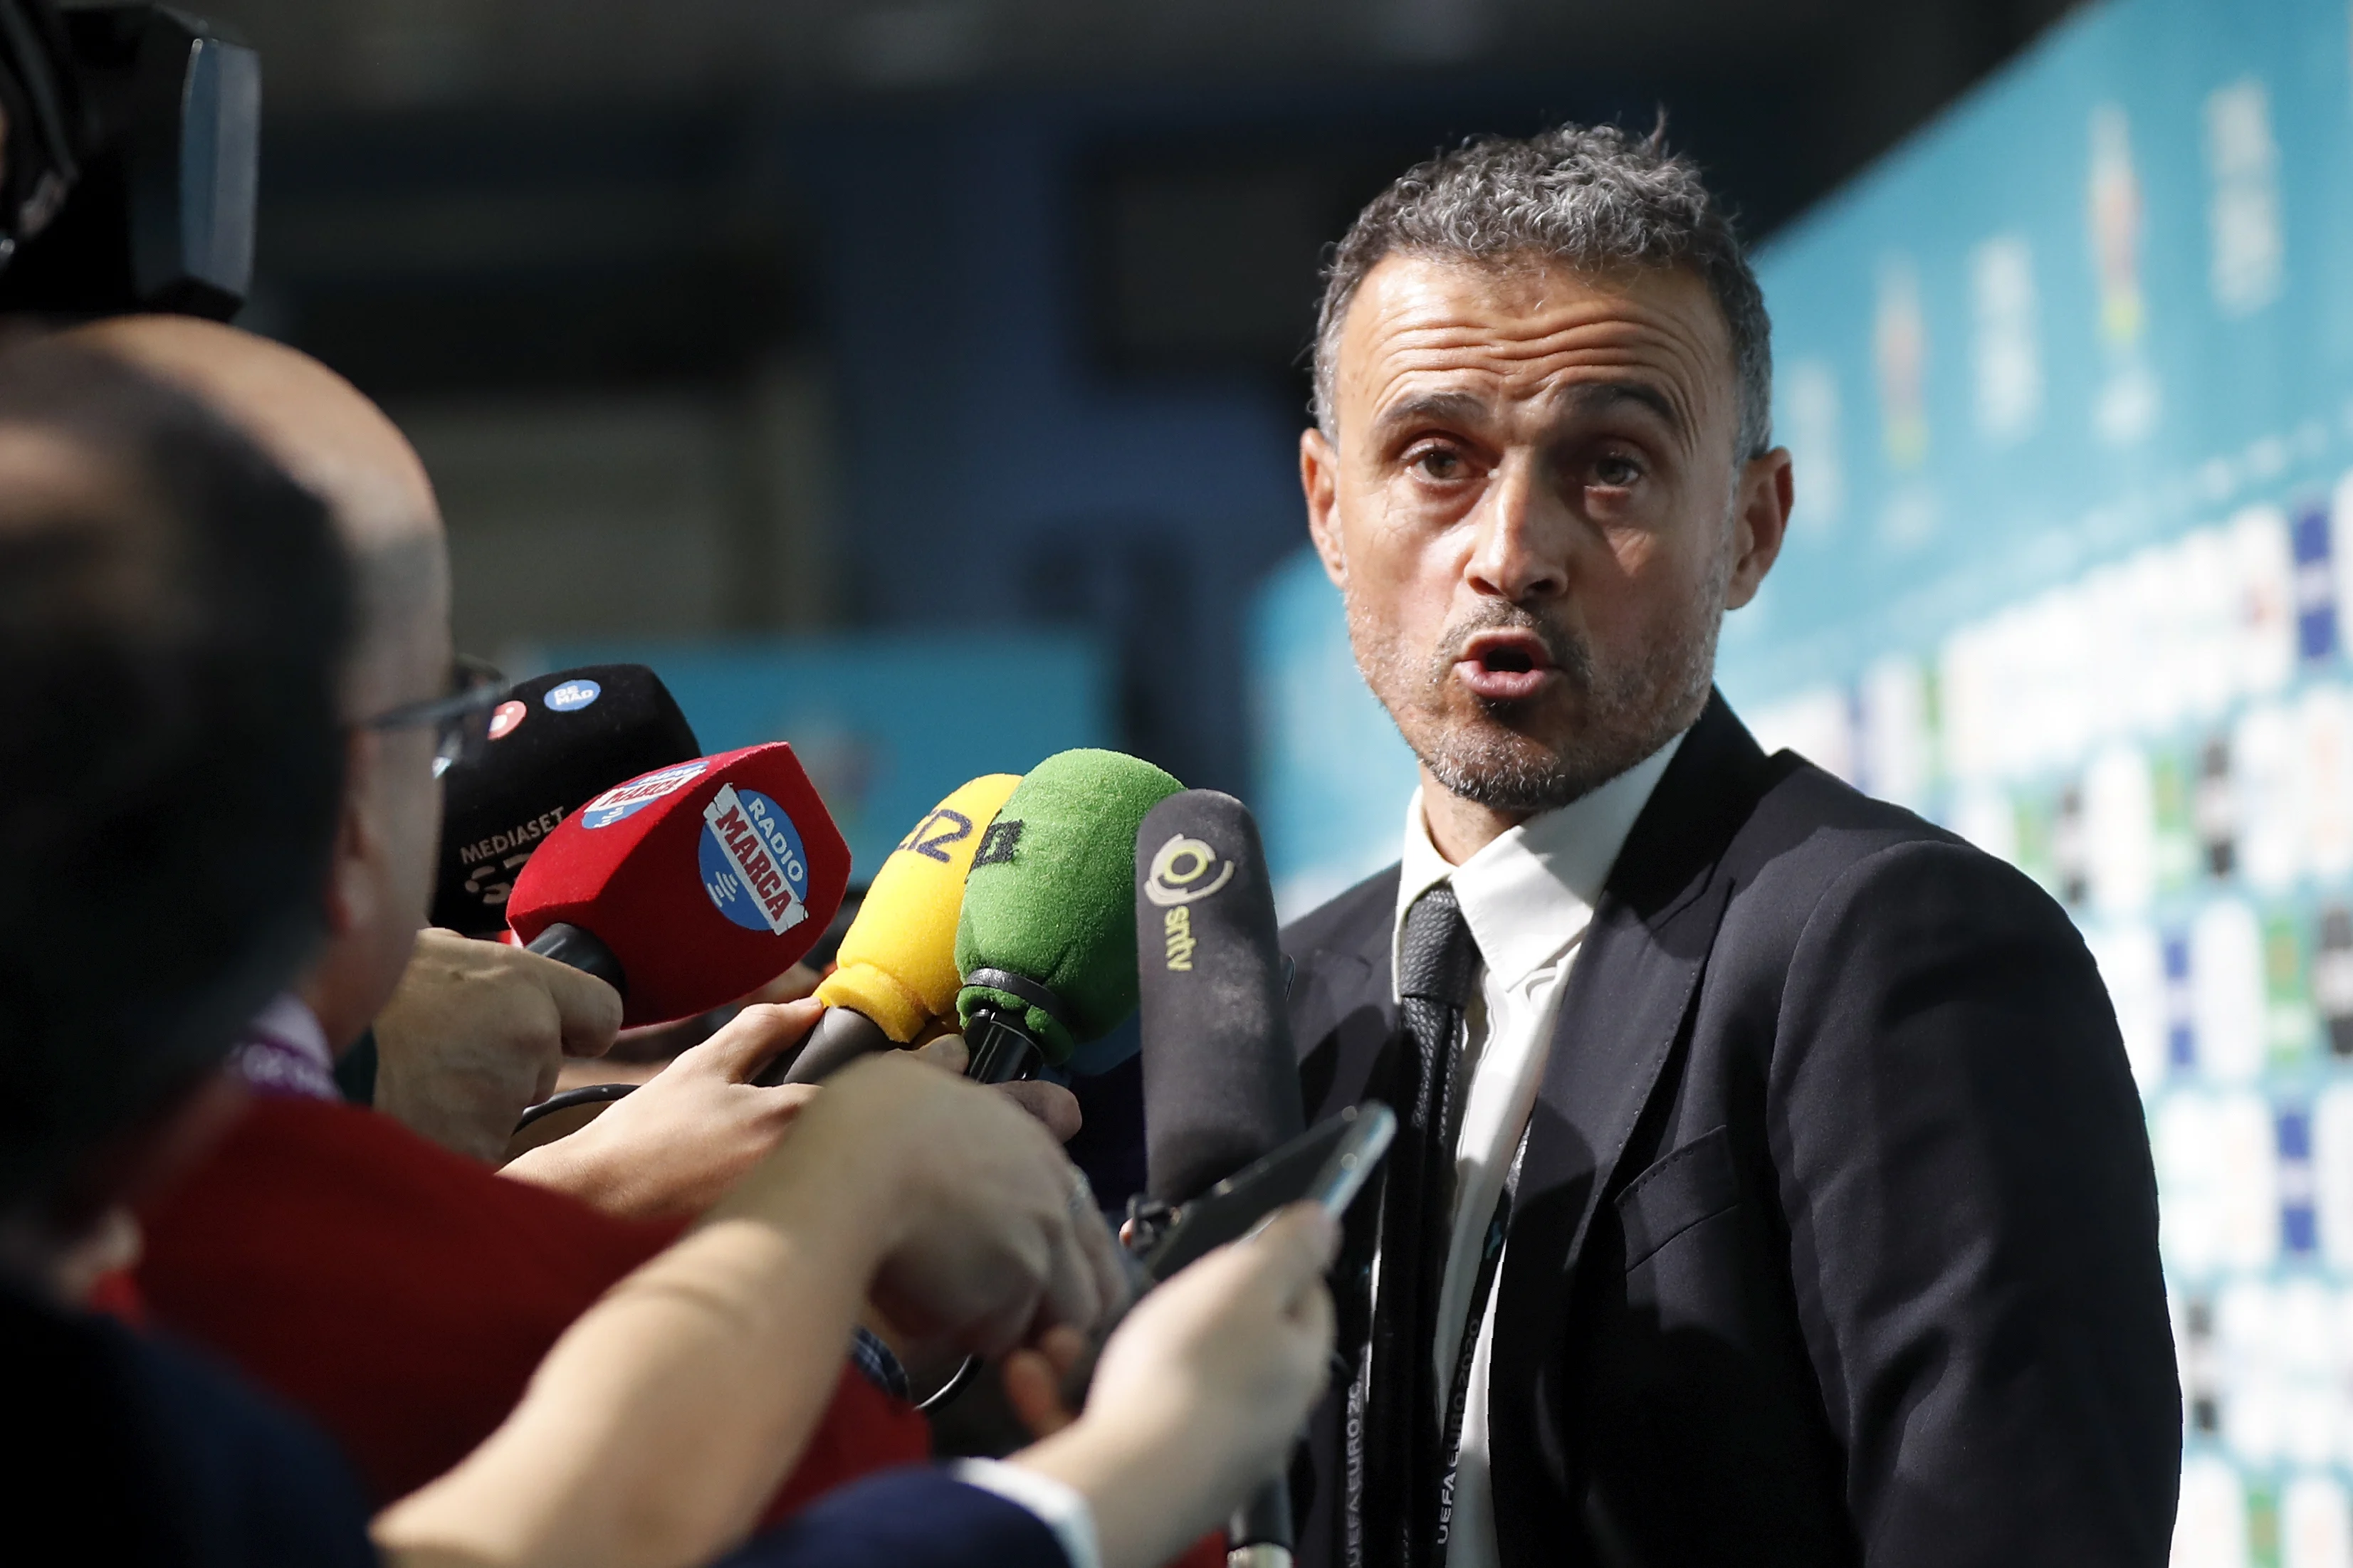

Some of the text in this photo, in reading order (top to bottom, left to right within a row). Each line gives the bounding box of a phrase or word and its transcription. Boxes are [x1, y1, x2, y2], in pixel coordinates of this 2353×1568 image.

[460, 805, 565, 865] MEDIASET
[715, 804, 792, 922] MARCA
[748, 797, 804, 882] RADIO
[1437, 1472, 1456, 1546] UEFA
[1447, 1394, 1465, 1468] EURO
